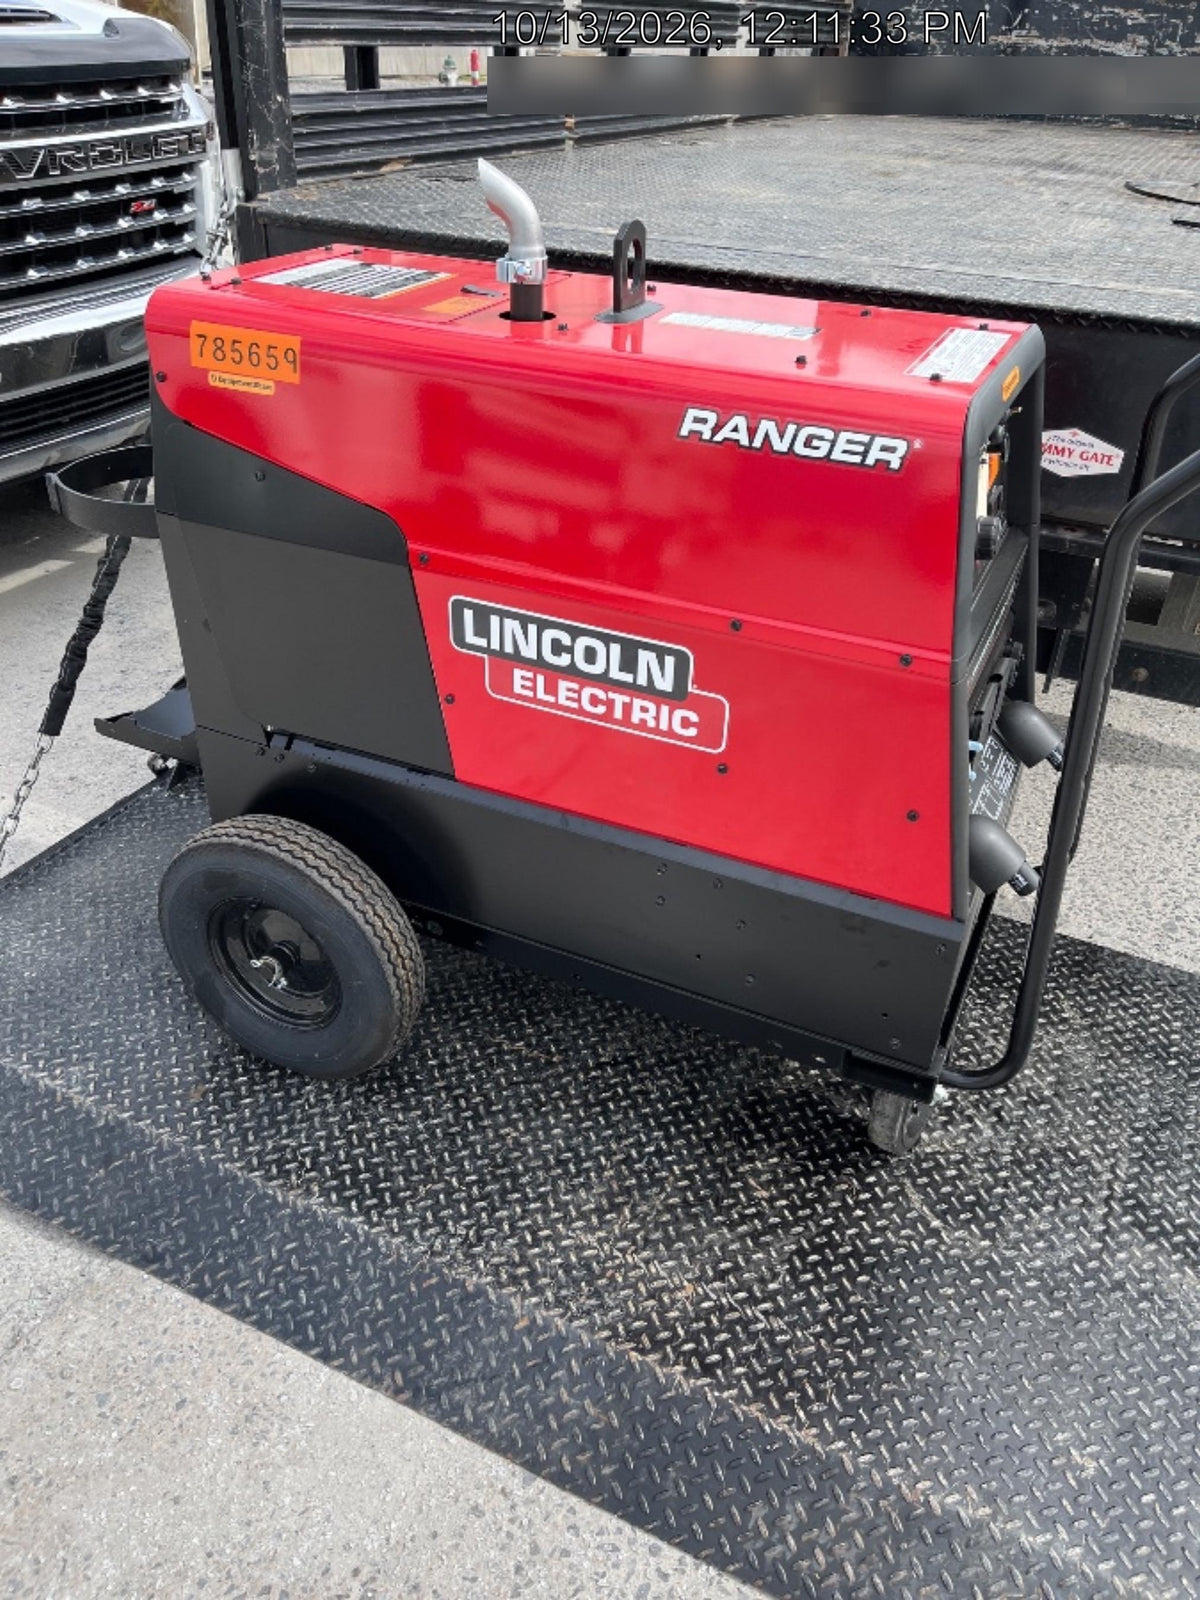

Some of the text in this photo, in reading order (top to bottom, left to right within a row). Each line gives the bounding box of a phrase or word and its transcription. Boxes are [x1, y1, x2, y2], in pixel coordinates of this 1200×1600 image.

[195, 333, 299, 374] 785659
[678, 407, 910, 471] RANGER
[1079, 450, 1115, 467] GATE
[463, 608, 676, 693] LINCOLN
[512, 668, 700, 737] ELECTRIC
